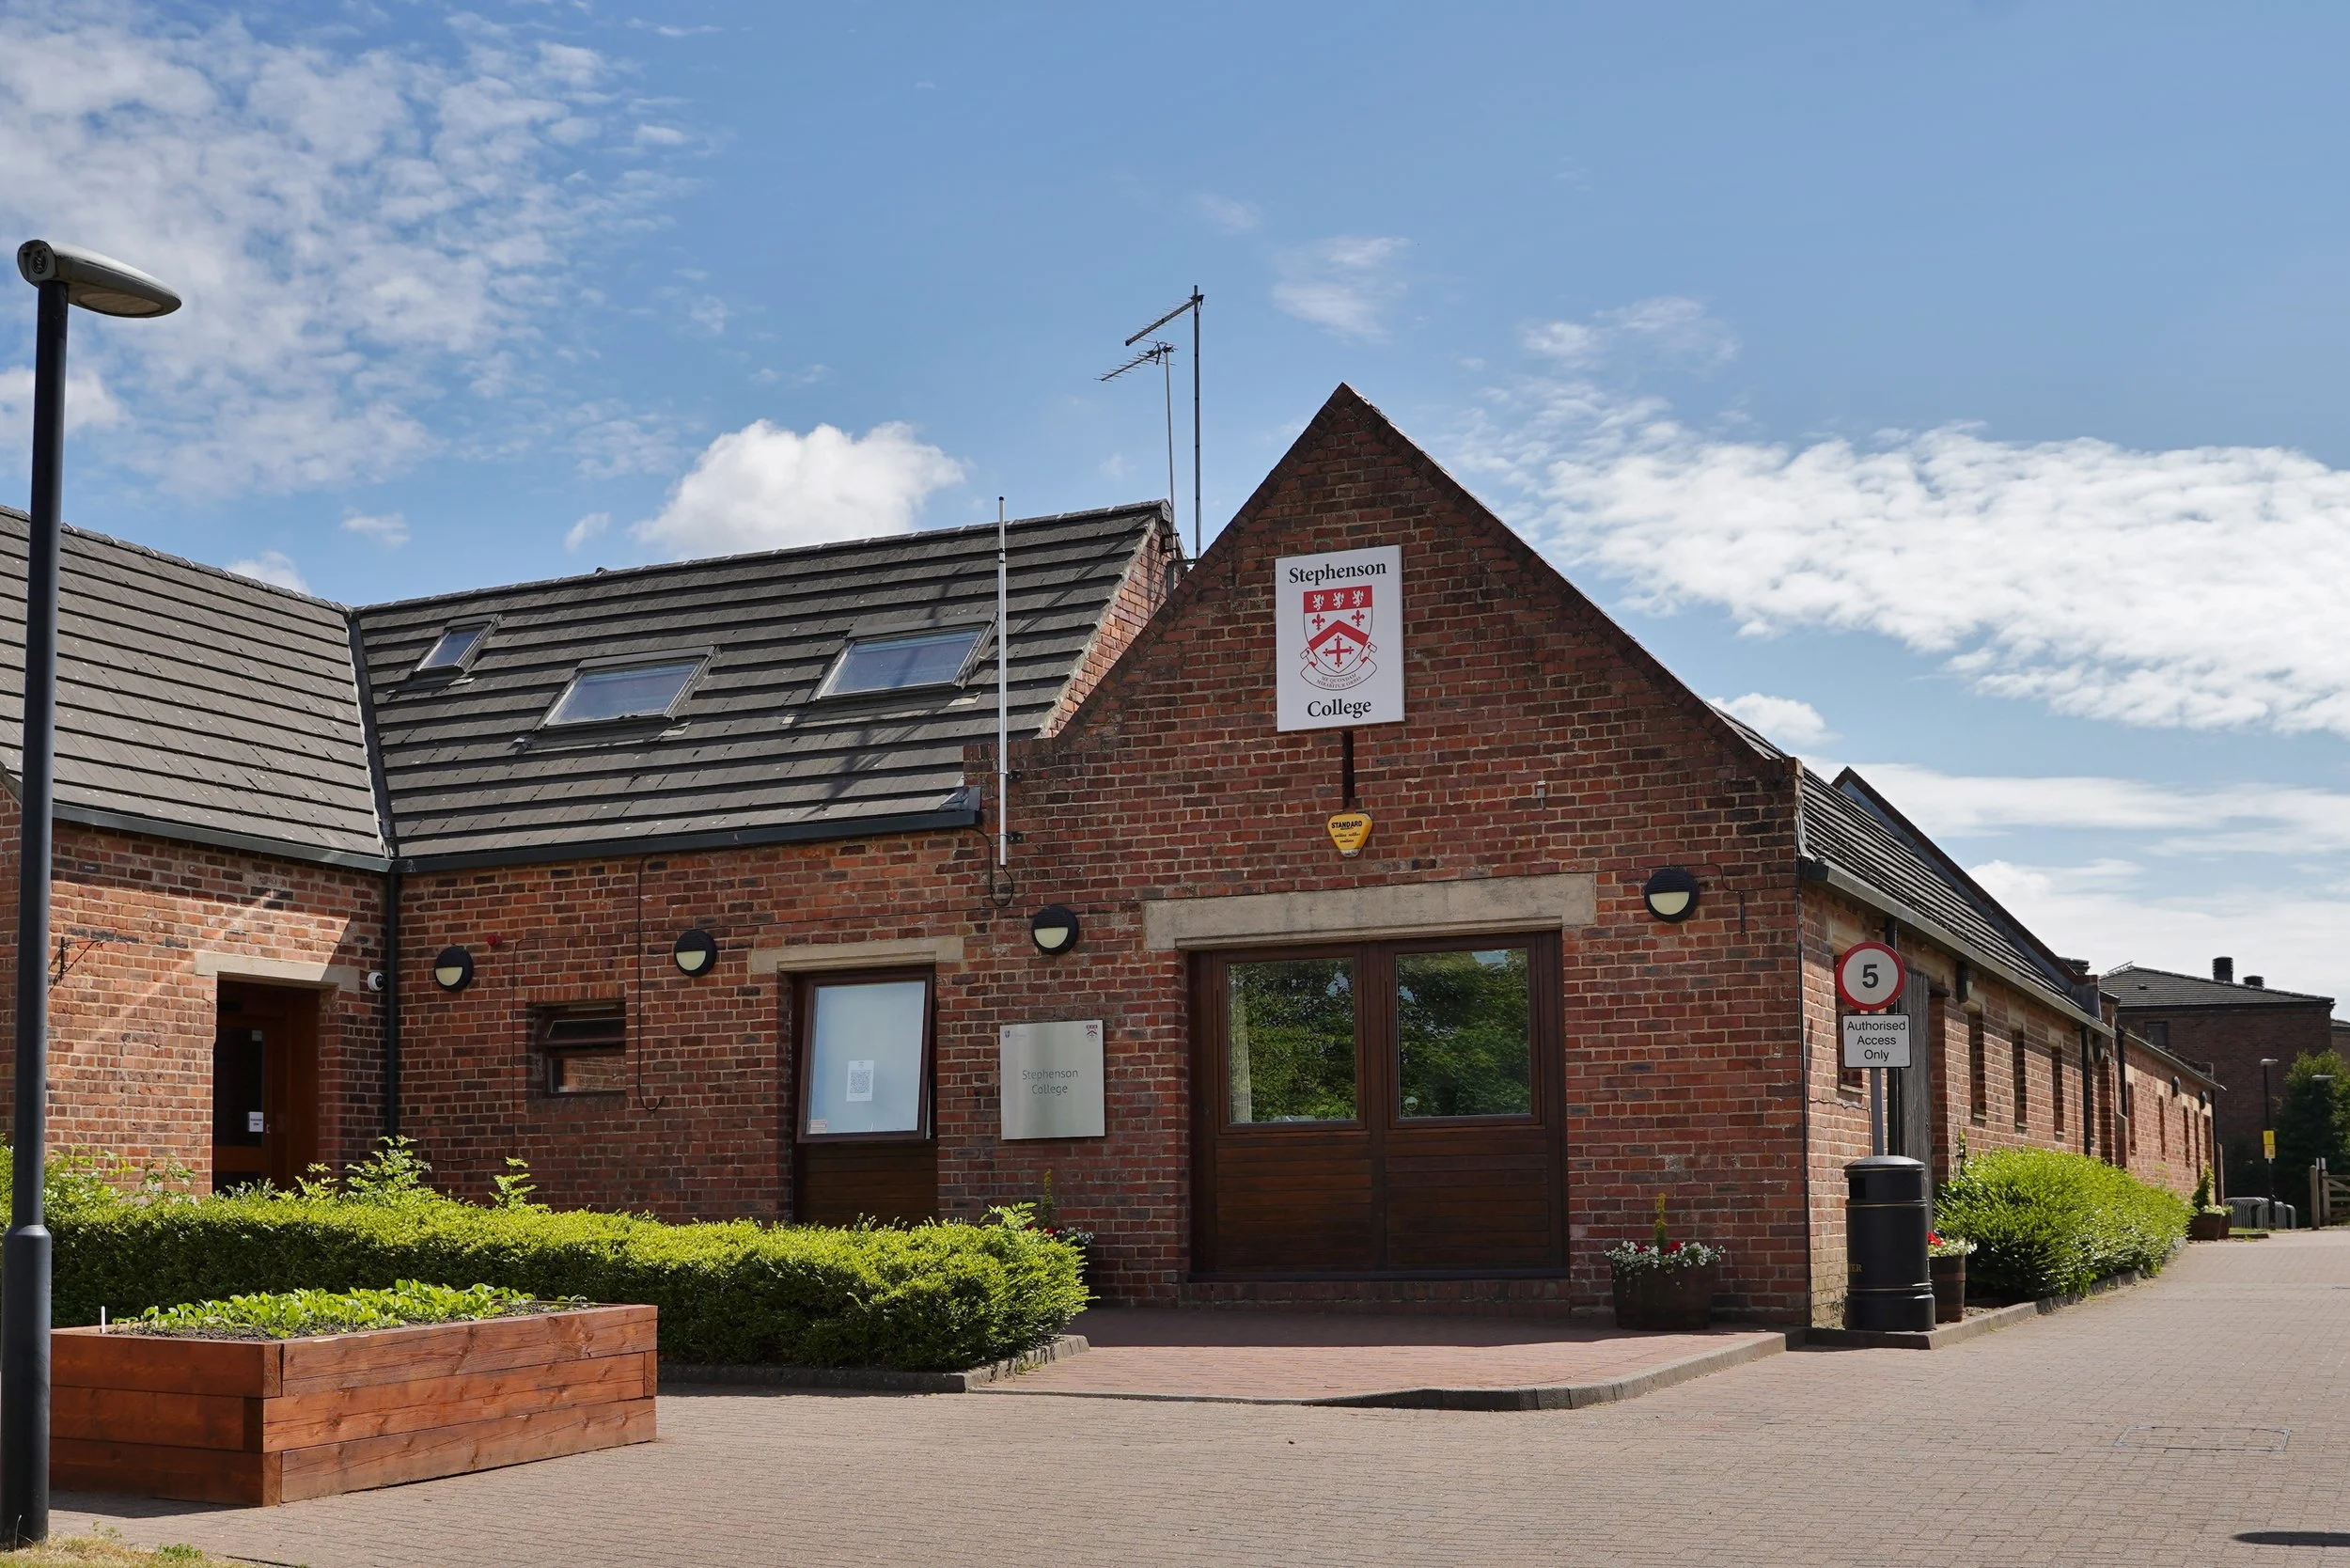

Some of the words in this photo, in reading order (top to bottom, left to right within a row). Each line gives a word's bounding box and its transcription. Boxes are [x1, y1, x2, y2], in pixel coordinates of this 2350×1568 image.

[1289, 562, 1386, 586] Stephenson
[1308, 698, 1371, 719] College
[1331, 820, 1362, 828] STANDARD
[1862, 964, 1879, 988] 5
[1847, 1021, 1905, 1031] Authorised
[1856, 1035, 1897, 1045] Access
[1864, 1049, 1889, 1062] Only
[1022, 1069, 1079, 1081] Stephenson
[1031, 1084, 1068, 1096] College
